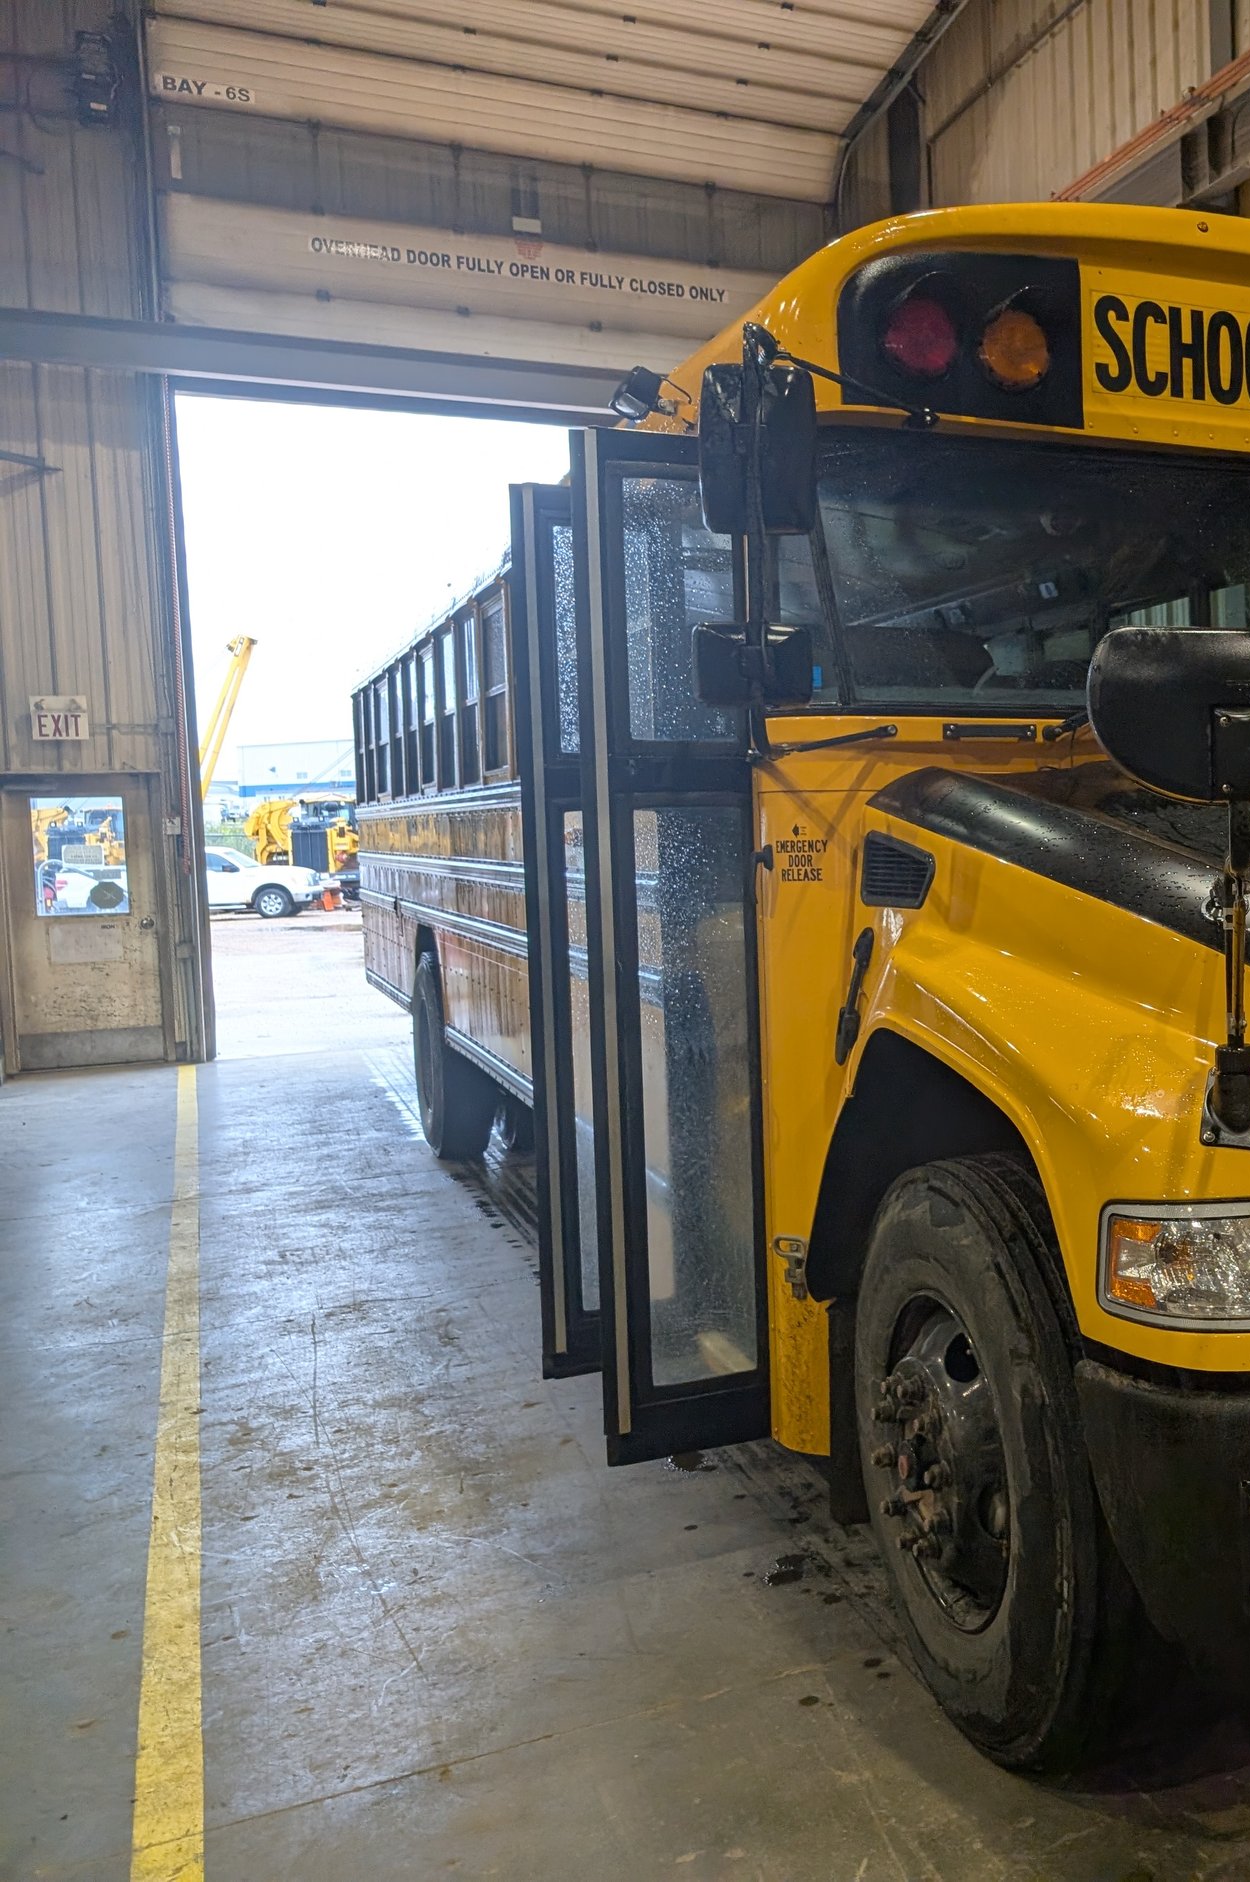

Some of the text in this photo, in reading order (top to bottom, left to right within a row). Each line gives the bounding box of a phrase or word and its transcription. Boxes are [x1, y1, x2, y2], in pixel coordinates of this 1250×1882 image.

[162, 76, 207, 95] BAY
[225, 87, 250, 102] 6S
[311, 237, 725, 302] OVERHEAD DOOR FULLY OPEN OR FULLY CLOSED ONLY
[37, 714, 81, 737] EXIT
[776, 840, 828, 853] EMERGENCY
[788, 854, 813, 867] DOOR
[781, 868, 823, 881] RELEASE
